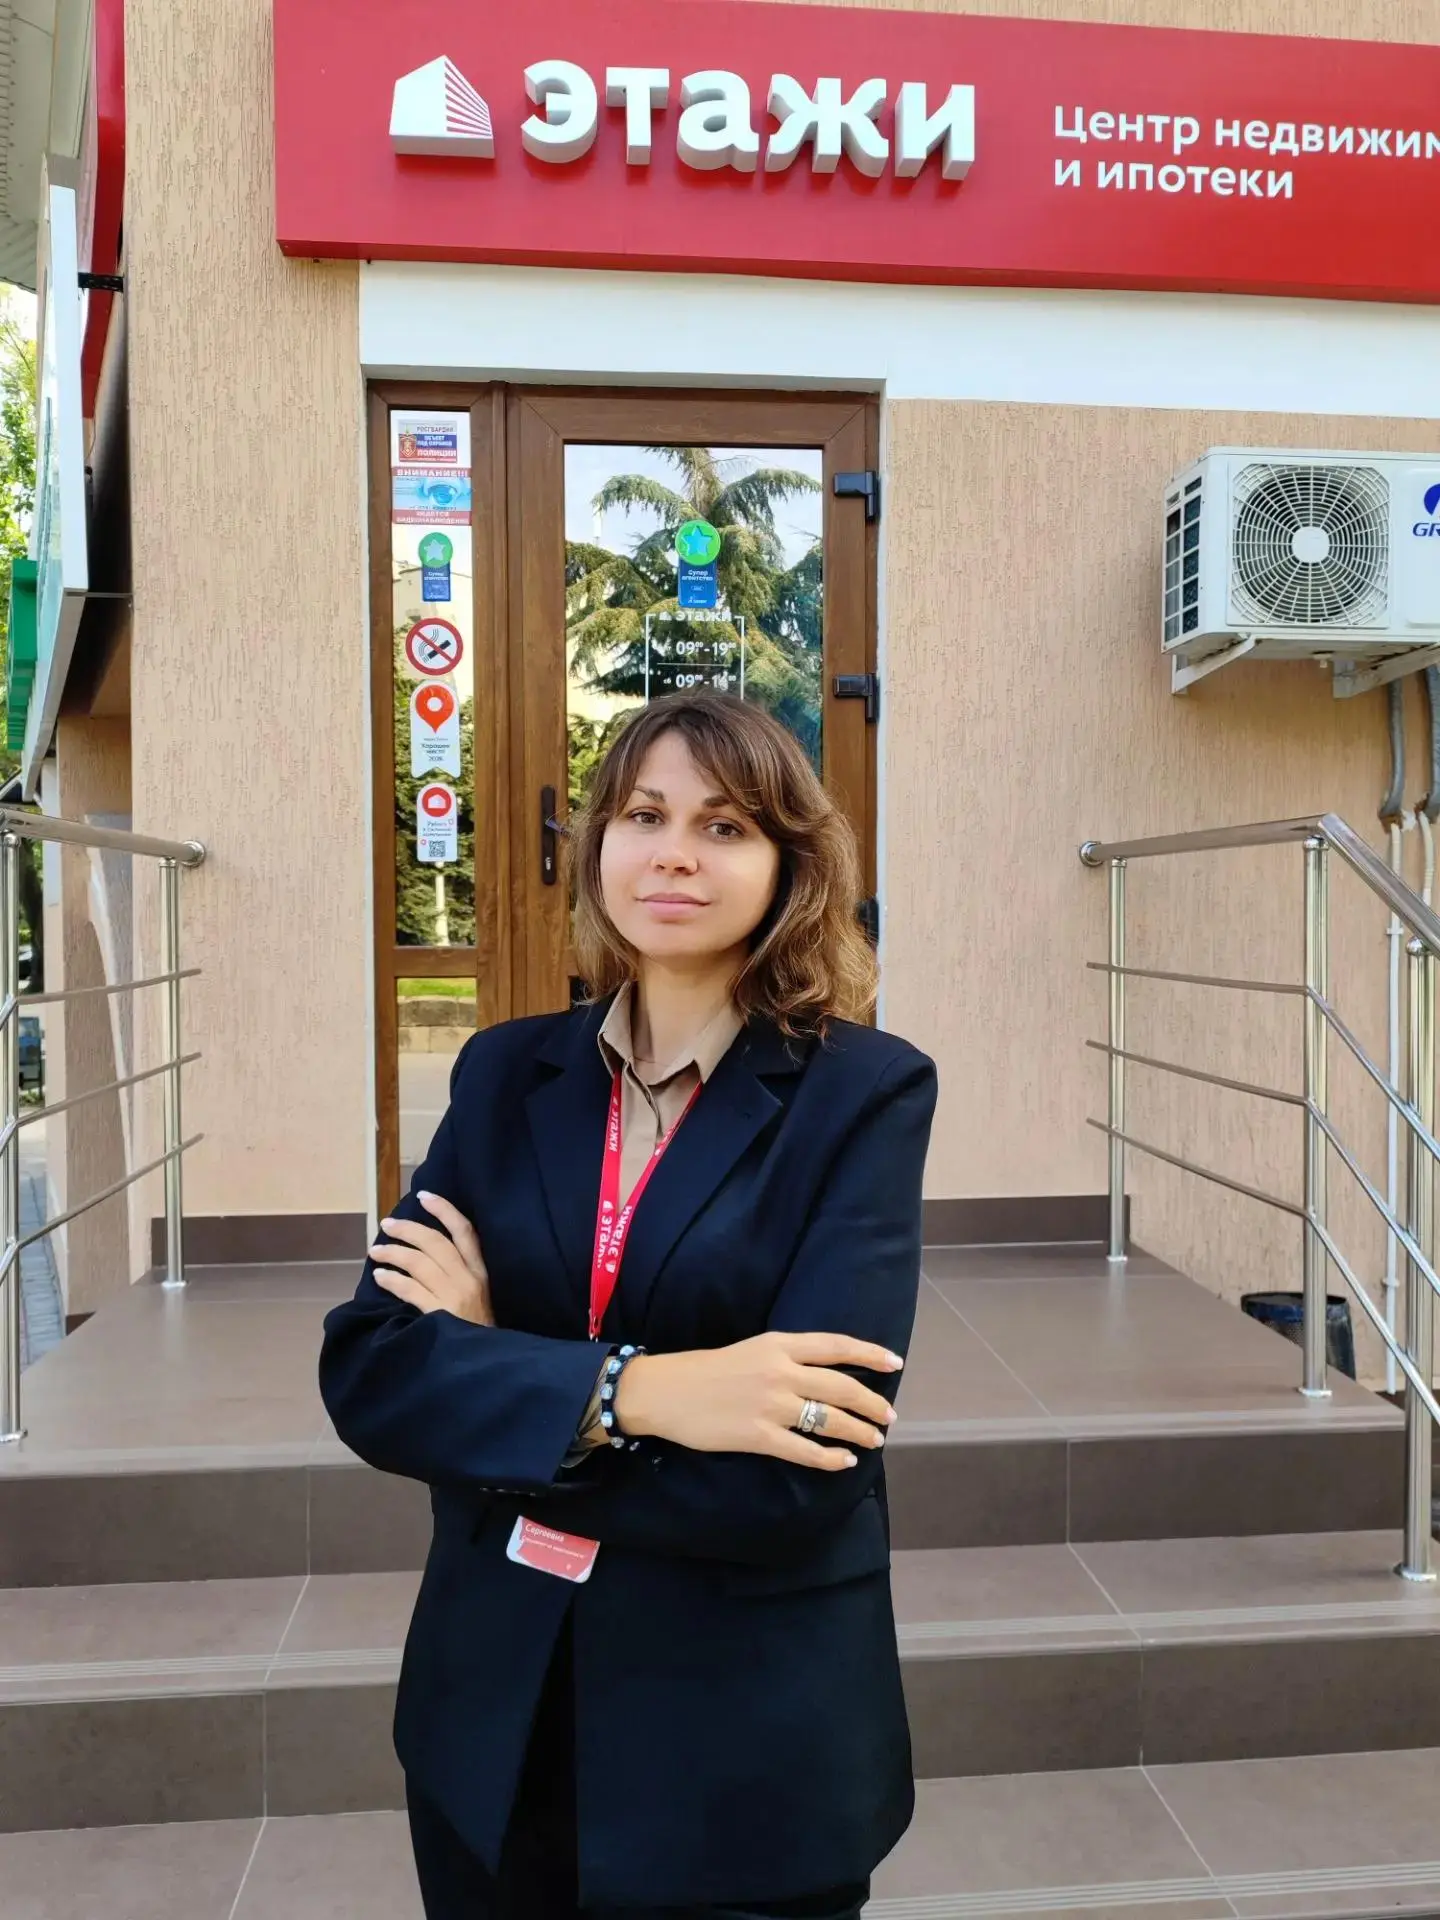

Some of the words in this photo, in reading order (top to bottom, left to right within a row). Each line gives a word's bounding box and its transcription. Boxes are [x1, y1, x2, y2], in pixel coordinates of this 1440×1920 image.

[1054, 105, 1200, 155] Центр
[1054, 158, 1081, 187] и
[1097, 160, 1294, 198] ипотеки
